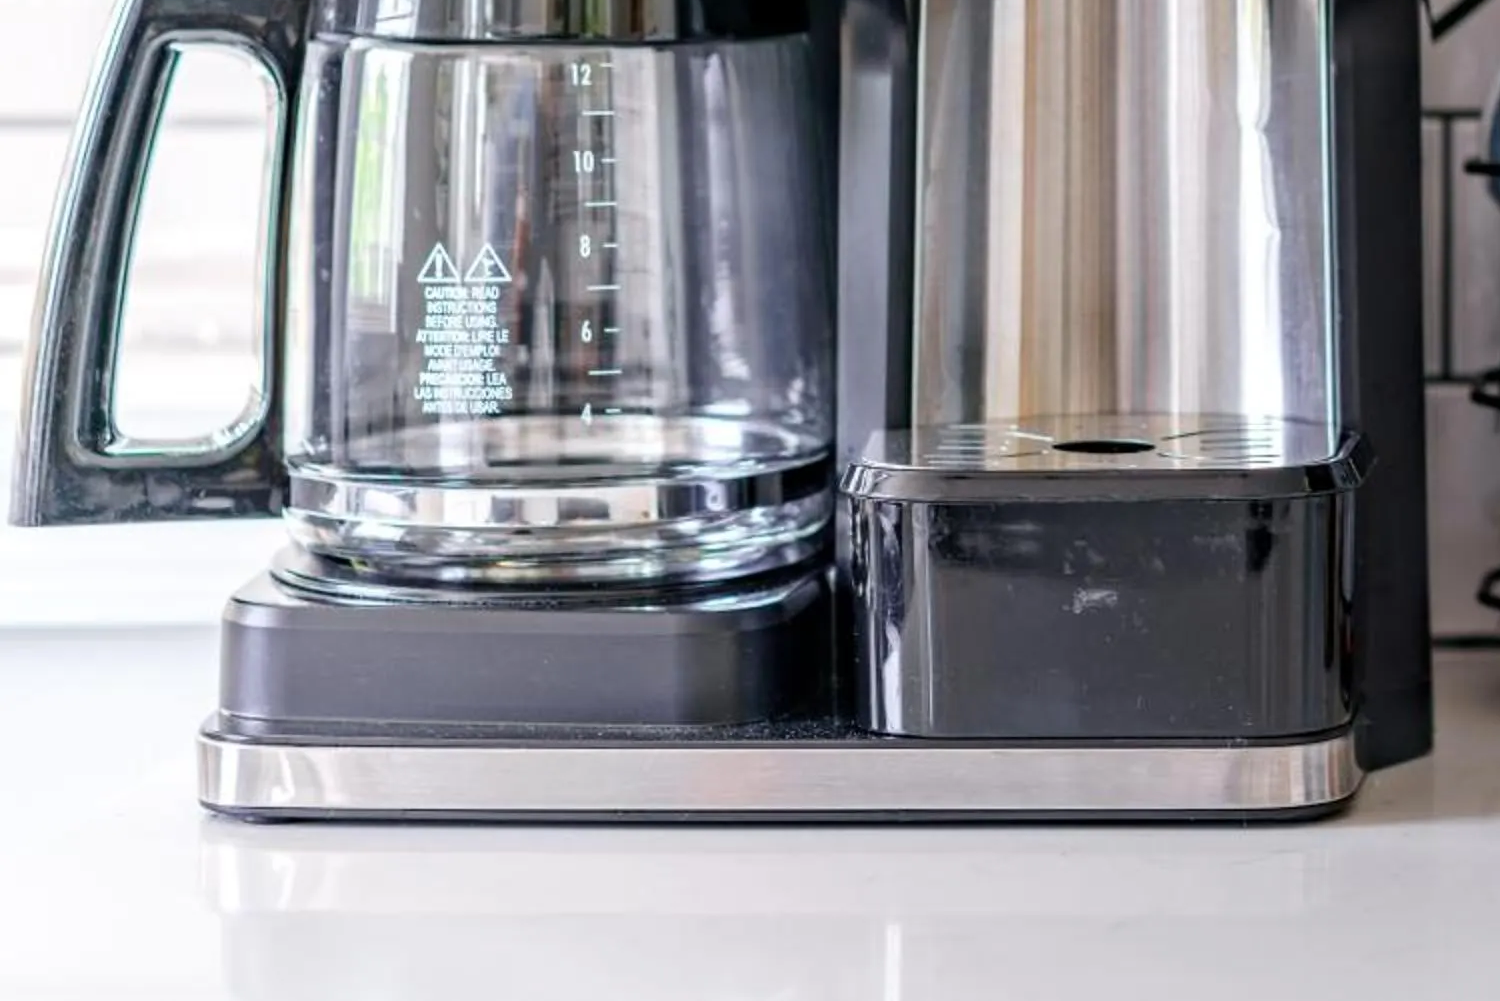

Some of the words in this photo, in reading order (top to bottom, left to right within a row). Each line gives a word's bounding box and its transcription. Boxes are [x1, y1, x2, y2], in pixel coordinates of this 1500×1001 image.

[571, 63, 593, 87] 12
[573, 150, 594, 173] 10
[579, 235, 591, 258] 8
[496, 329, 509, 343] LE
[581, 320, 592, 343] 6
[486, 372, 507, 386] LEA
[580, 403, 592, 426] 4
